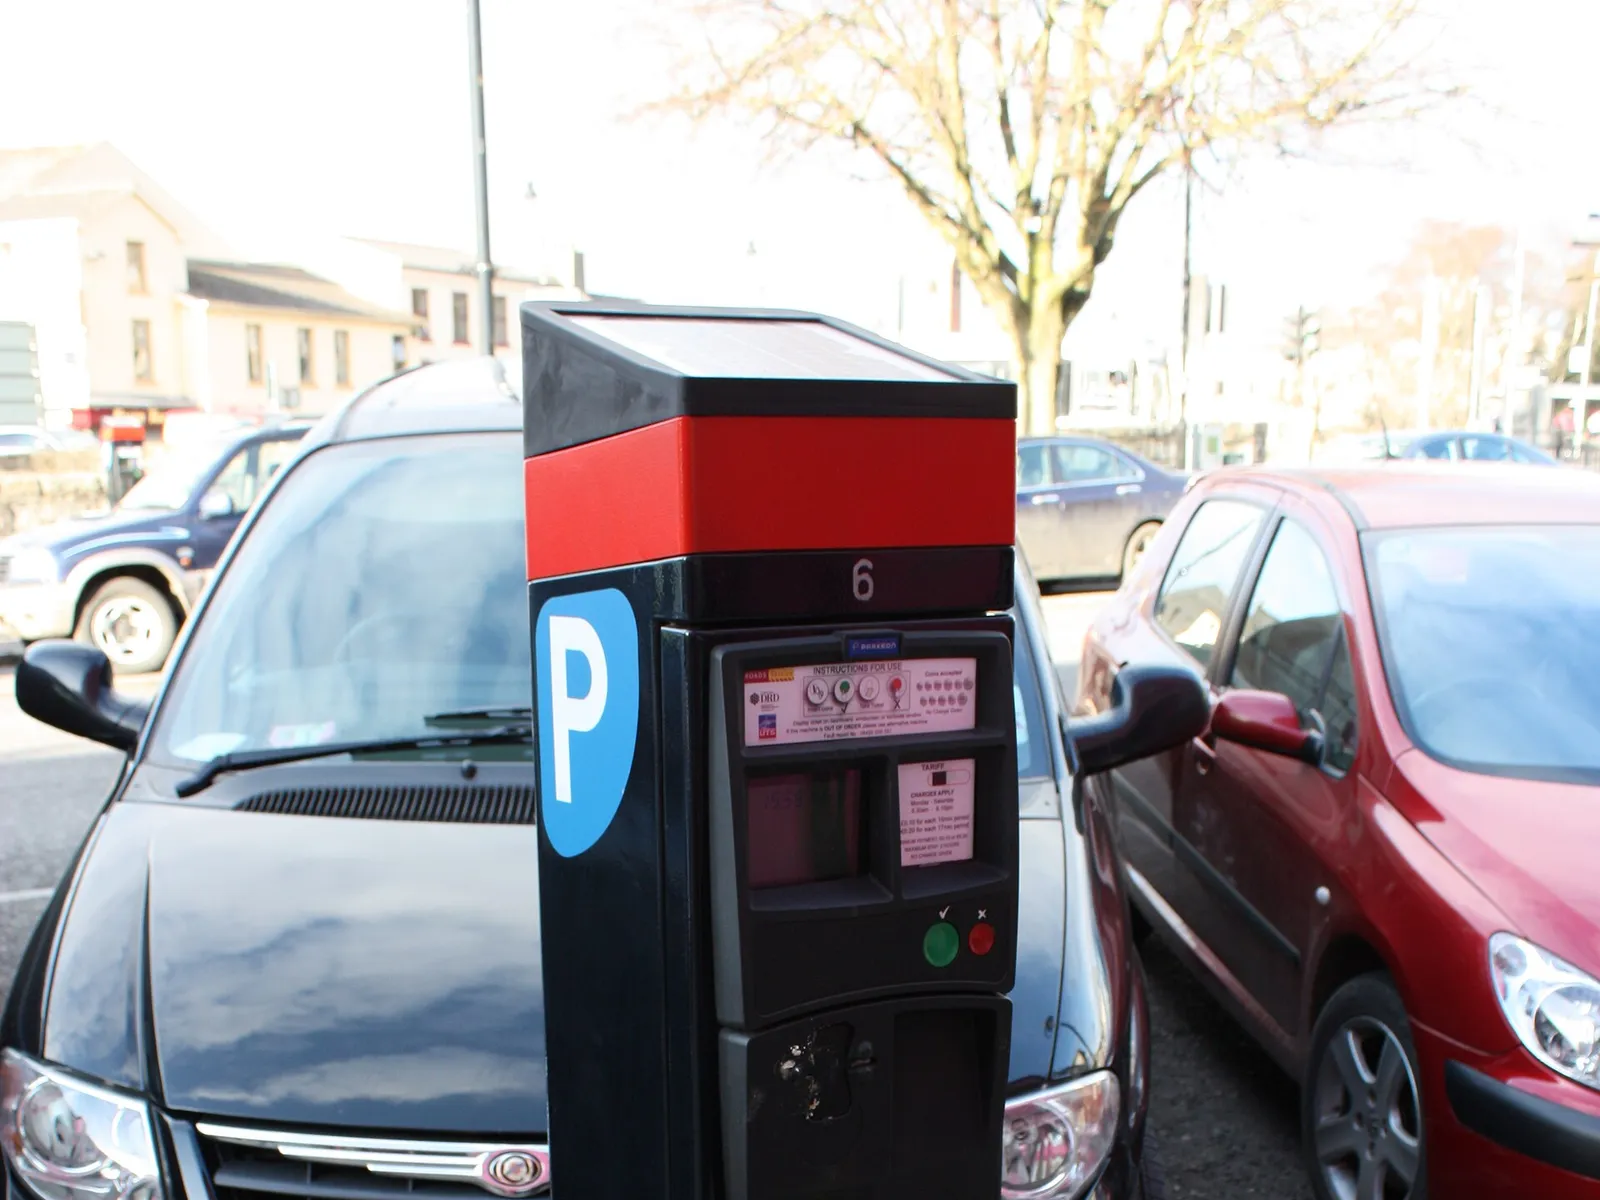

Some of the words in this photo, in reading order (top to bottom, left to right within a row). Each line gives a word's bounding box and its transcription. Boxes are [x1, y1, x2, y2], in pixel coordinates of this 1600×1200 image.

[852, 558, 874, 601] 6
[813, 664, 869, 675] INSTRUCTIONS
[870, 663, 886, 672] FOR
[887, 662, 901, 671] USE
[760, 693, 780, 703] DRD
[548, 614, 608, 804] P
[921, 763, 945, 771] TARIFF
[910, 790, 937, 799] CHARGES
[938, 788, 955, 797] APPLY
